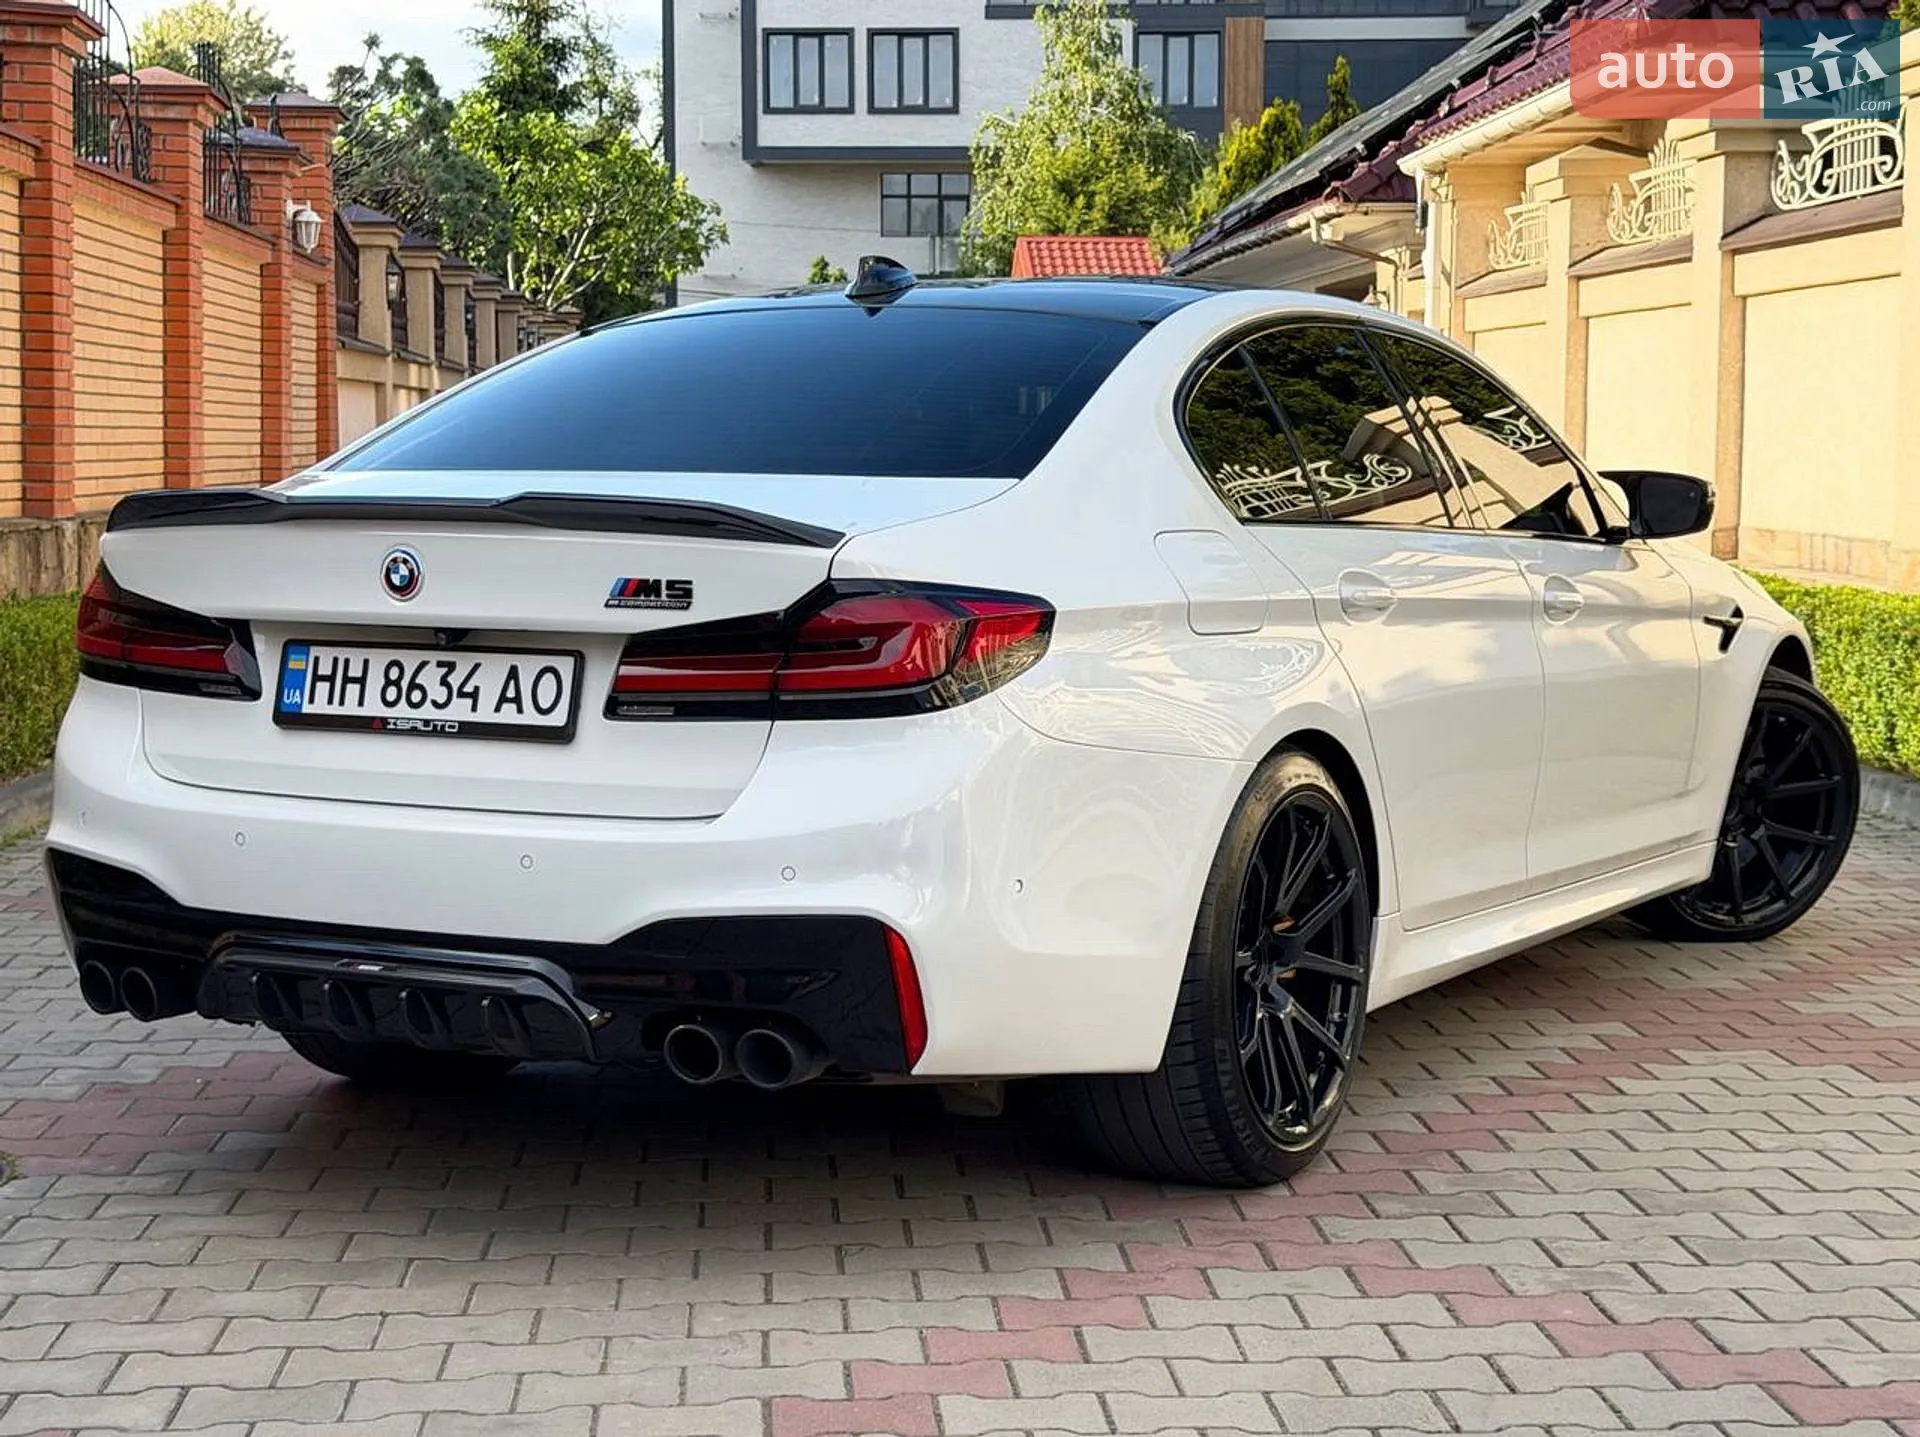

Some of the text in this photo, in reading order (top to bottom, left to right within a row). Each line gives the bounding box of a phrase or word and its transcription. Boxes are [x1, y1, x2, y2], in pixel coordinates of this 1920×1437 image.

[631, 578, 693, 599] M5
[283, 687, 301, 705] UA
[308, 655, 564, 716] HH 8634 AO
